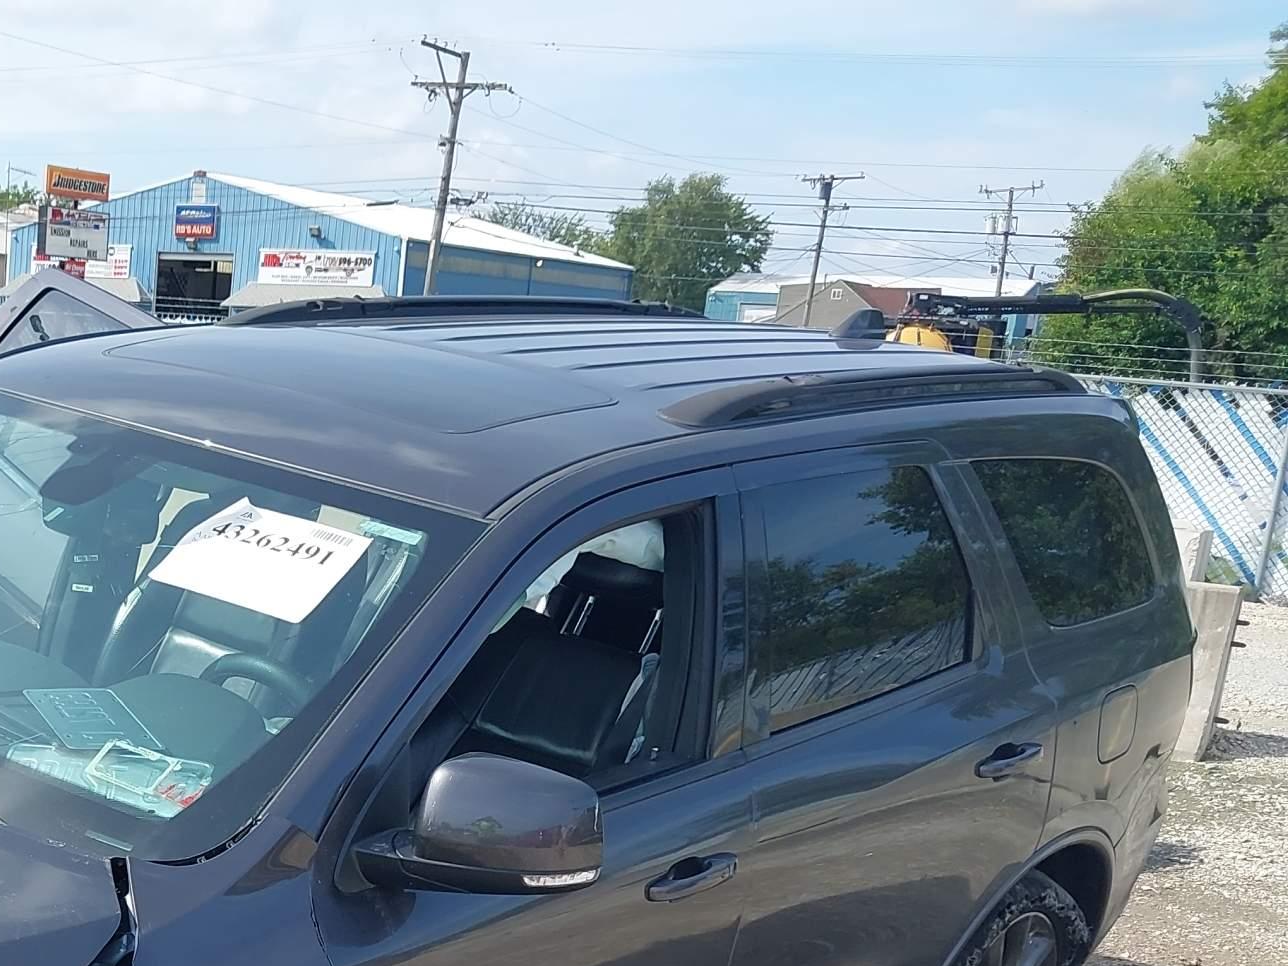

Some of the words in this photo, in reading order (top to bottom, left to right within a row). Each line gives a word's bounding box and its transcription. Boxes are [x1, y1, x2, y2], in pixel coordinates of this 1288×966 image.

[53, 174, 107, 195] BRIDGESTONE
[192, 223, 212, 234] AUTO
[212, 521, 336, 567] 43262491
